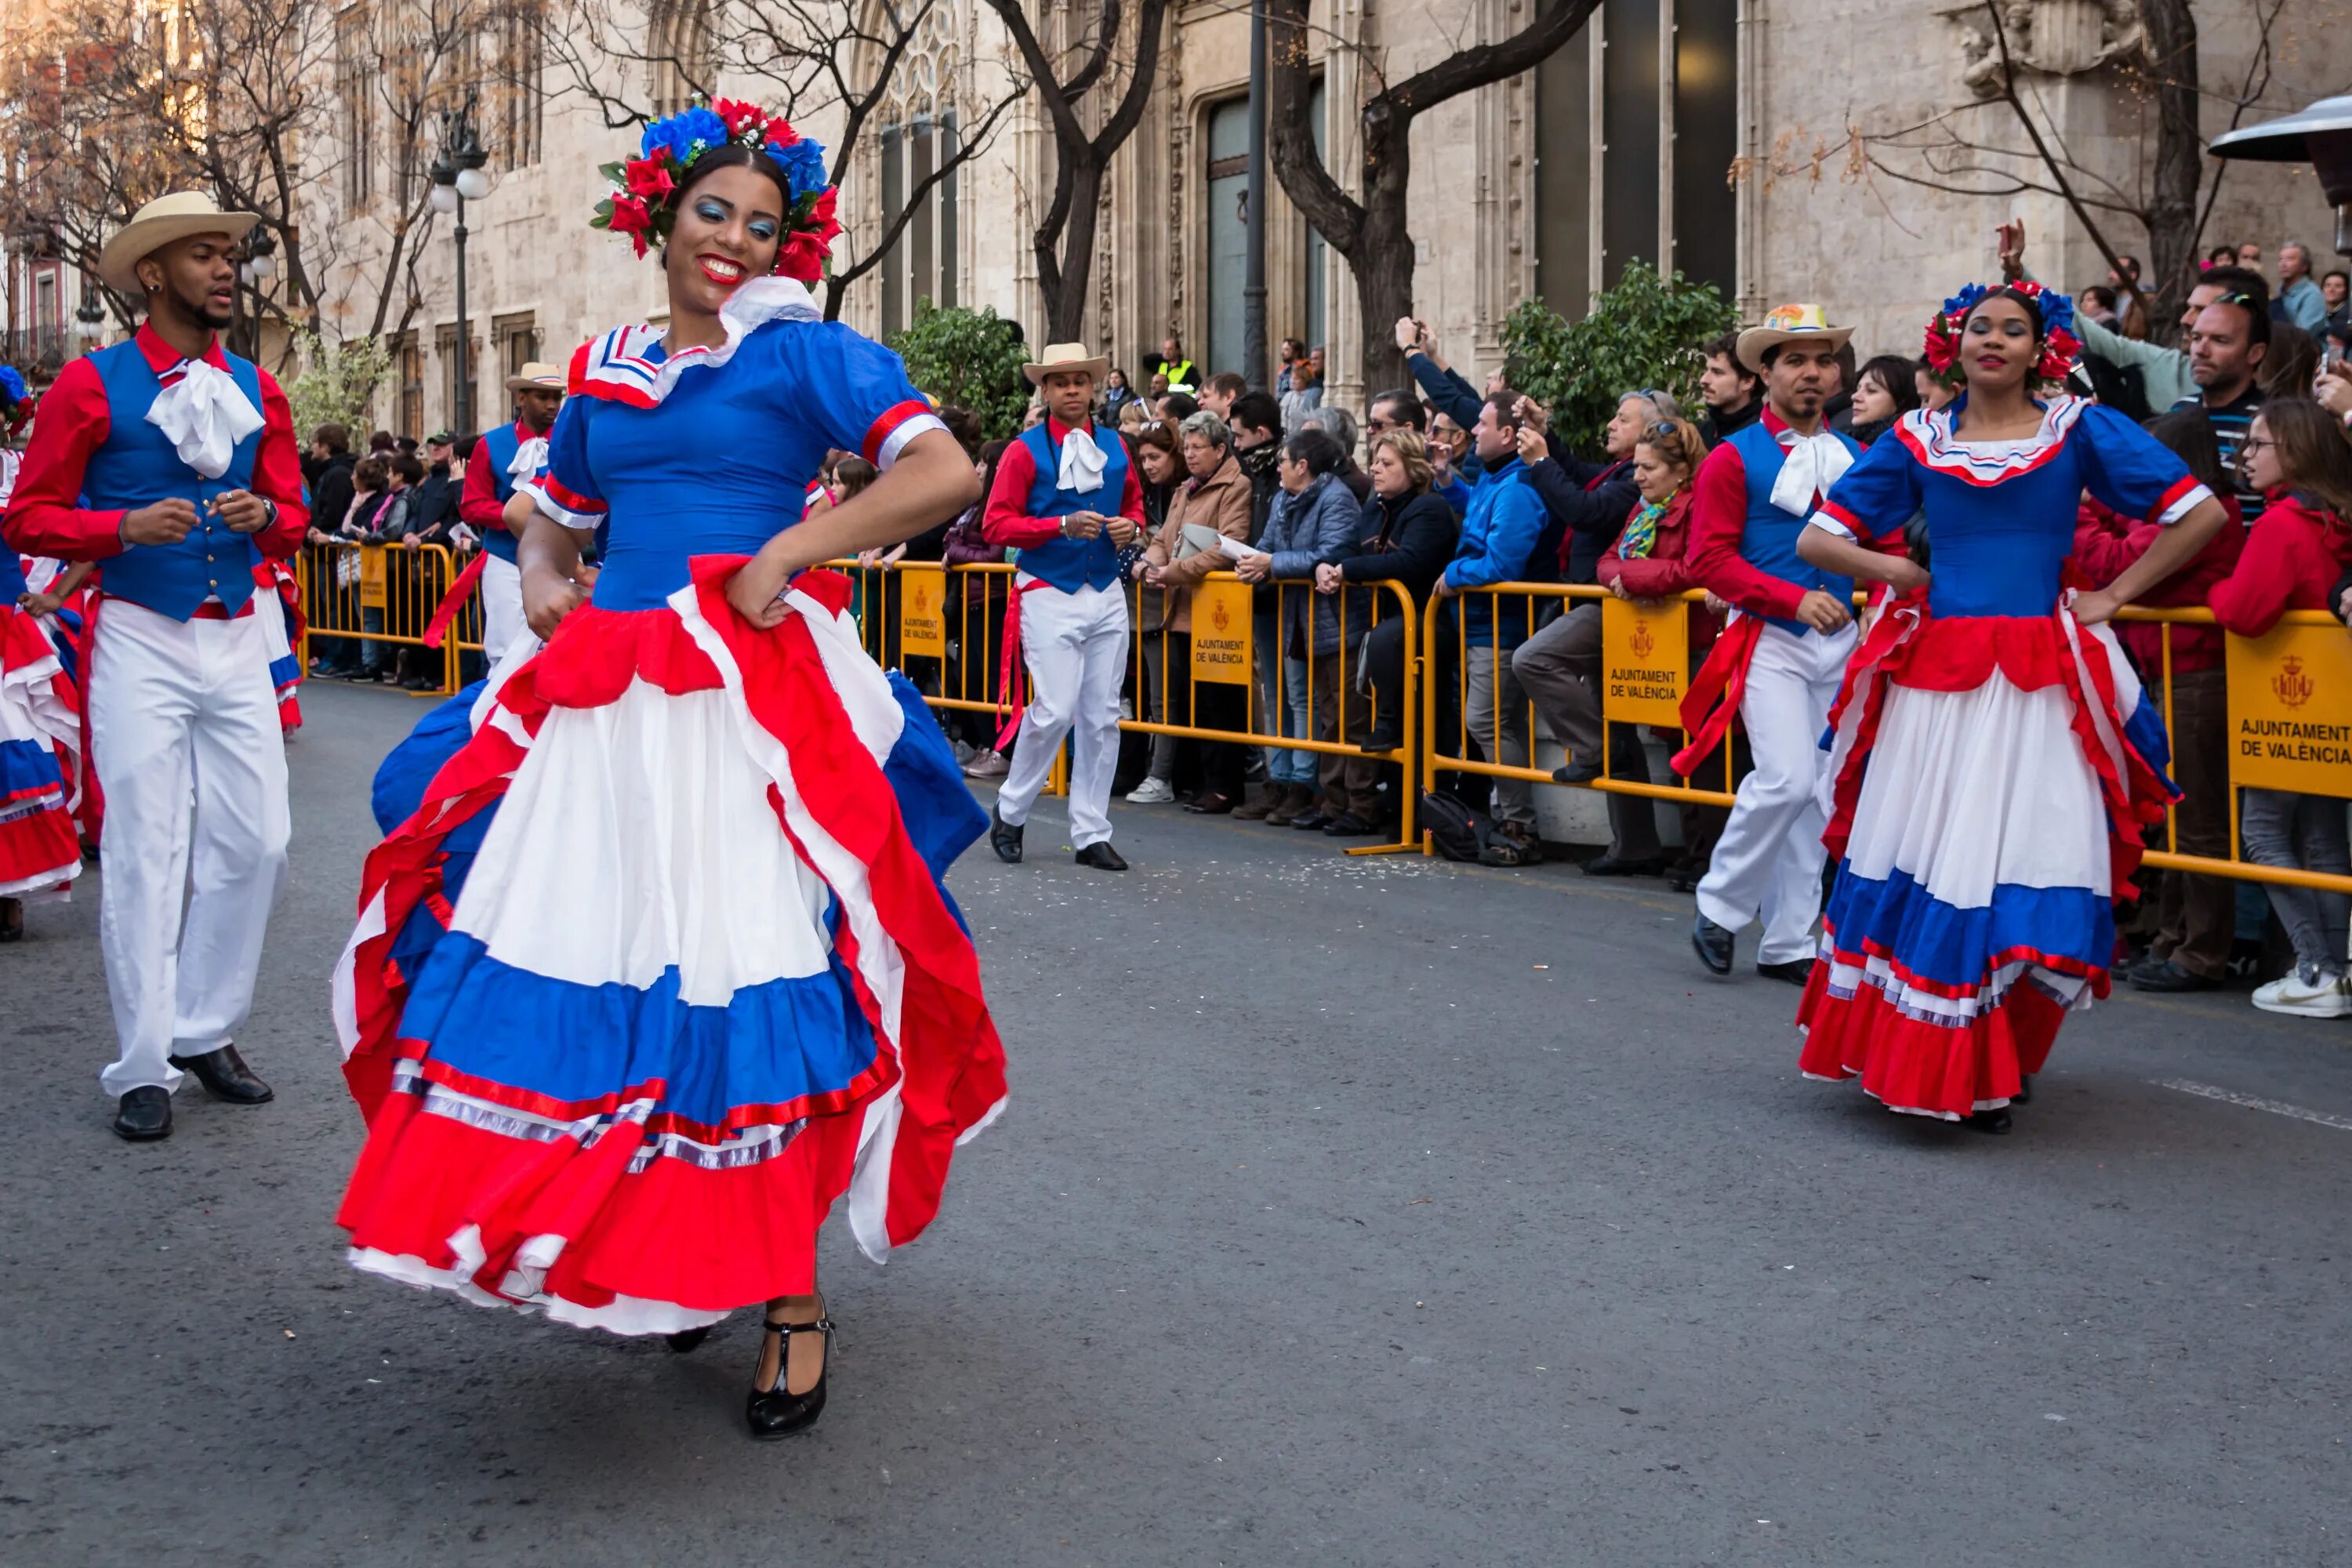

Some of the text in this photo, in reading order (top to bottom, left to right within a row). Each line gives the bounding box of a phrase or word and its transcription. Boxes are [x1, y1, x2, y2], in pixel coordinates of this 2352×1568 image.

[1196, 639, 1244, 651] AJUNTAMENT
[1196, 652, 1206, 662] DE
[1611, 668, 1676, 684] AJUNTAMENT
[1610, 684, 1677, 701] DE VALÈNCIA
[2241, 719, 2351, 742] AJUNTAMENT
[2241, 739, 2352, 765] DE VALÈNCIA
